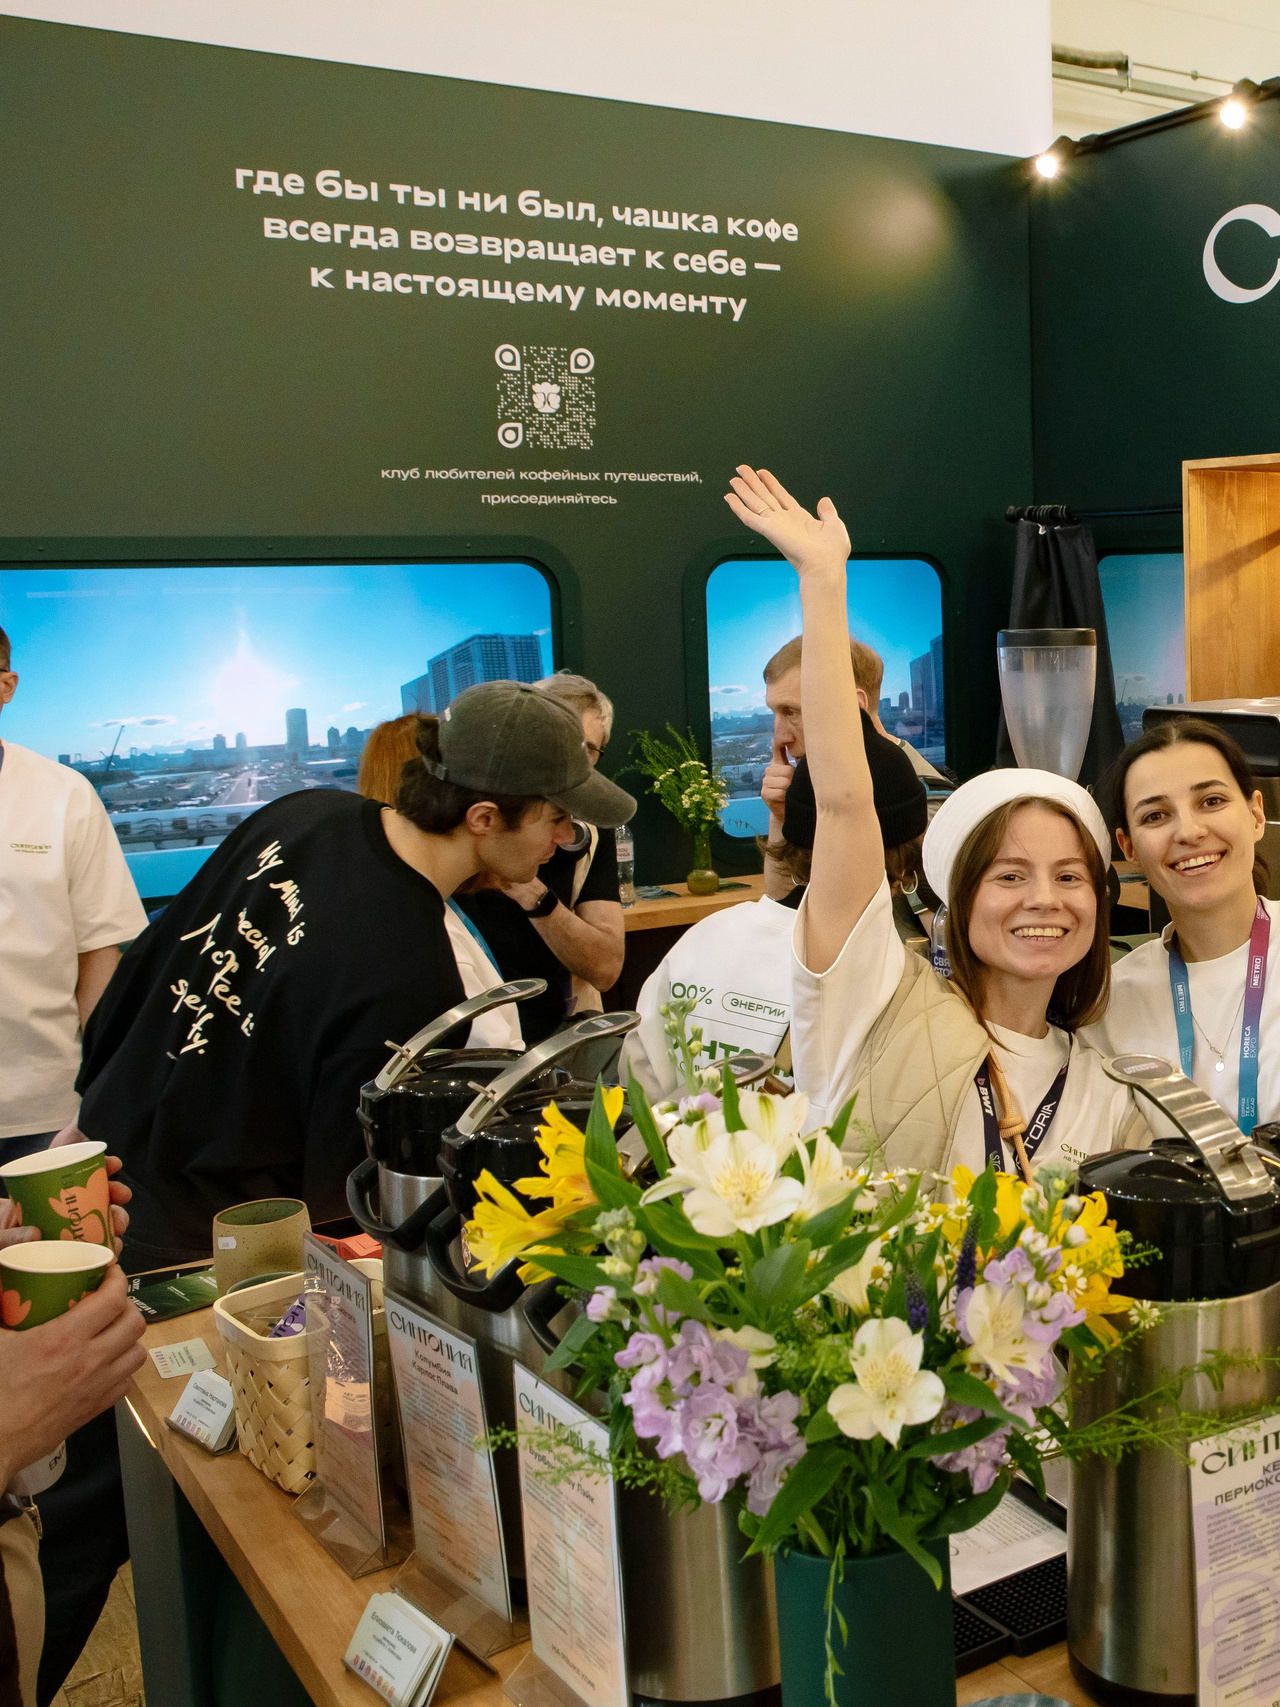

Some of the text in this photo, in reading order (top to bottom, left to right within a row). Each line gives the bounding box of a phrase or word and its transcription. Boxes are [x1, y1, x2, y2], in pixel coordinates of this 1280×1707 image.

[235, 166, 798, 244] где бы ты ни был, чашка кофе
[263, 216, 399, 249] всегда
[410, 230, 635, 268] возвращает
[645, 251, 665, 269] к
[673, 248, 746, 277] себе
[310, 267, 746, 321] к настоящему моменту
[381, 467, 703, 485] клуб любителей кофейных путешествий,
[481, 492, 617, 506] присоединяйтесь
[247, 841, 305, 945] My Mind is
[1253, 957, 1262, 986] METRO
[730, 998, 785, 1018] ЭНЕРГИИ
[1177, 984, 1185, 1013] METRO
[1243, 1026, 1251, 1058] HORECA
[979, 1086, 993, 1117] BWT
[1024, 1101, 1056, 1149] TORIA
[308, 1254, 364, 1311] СИНТОНИЯ
[391, 1311, 473, 1373] СИНТОНИЯ
